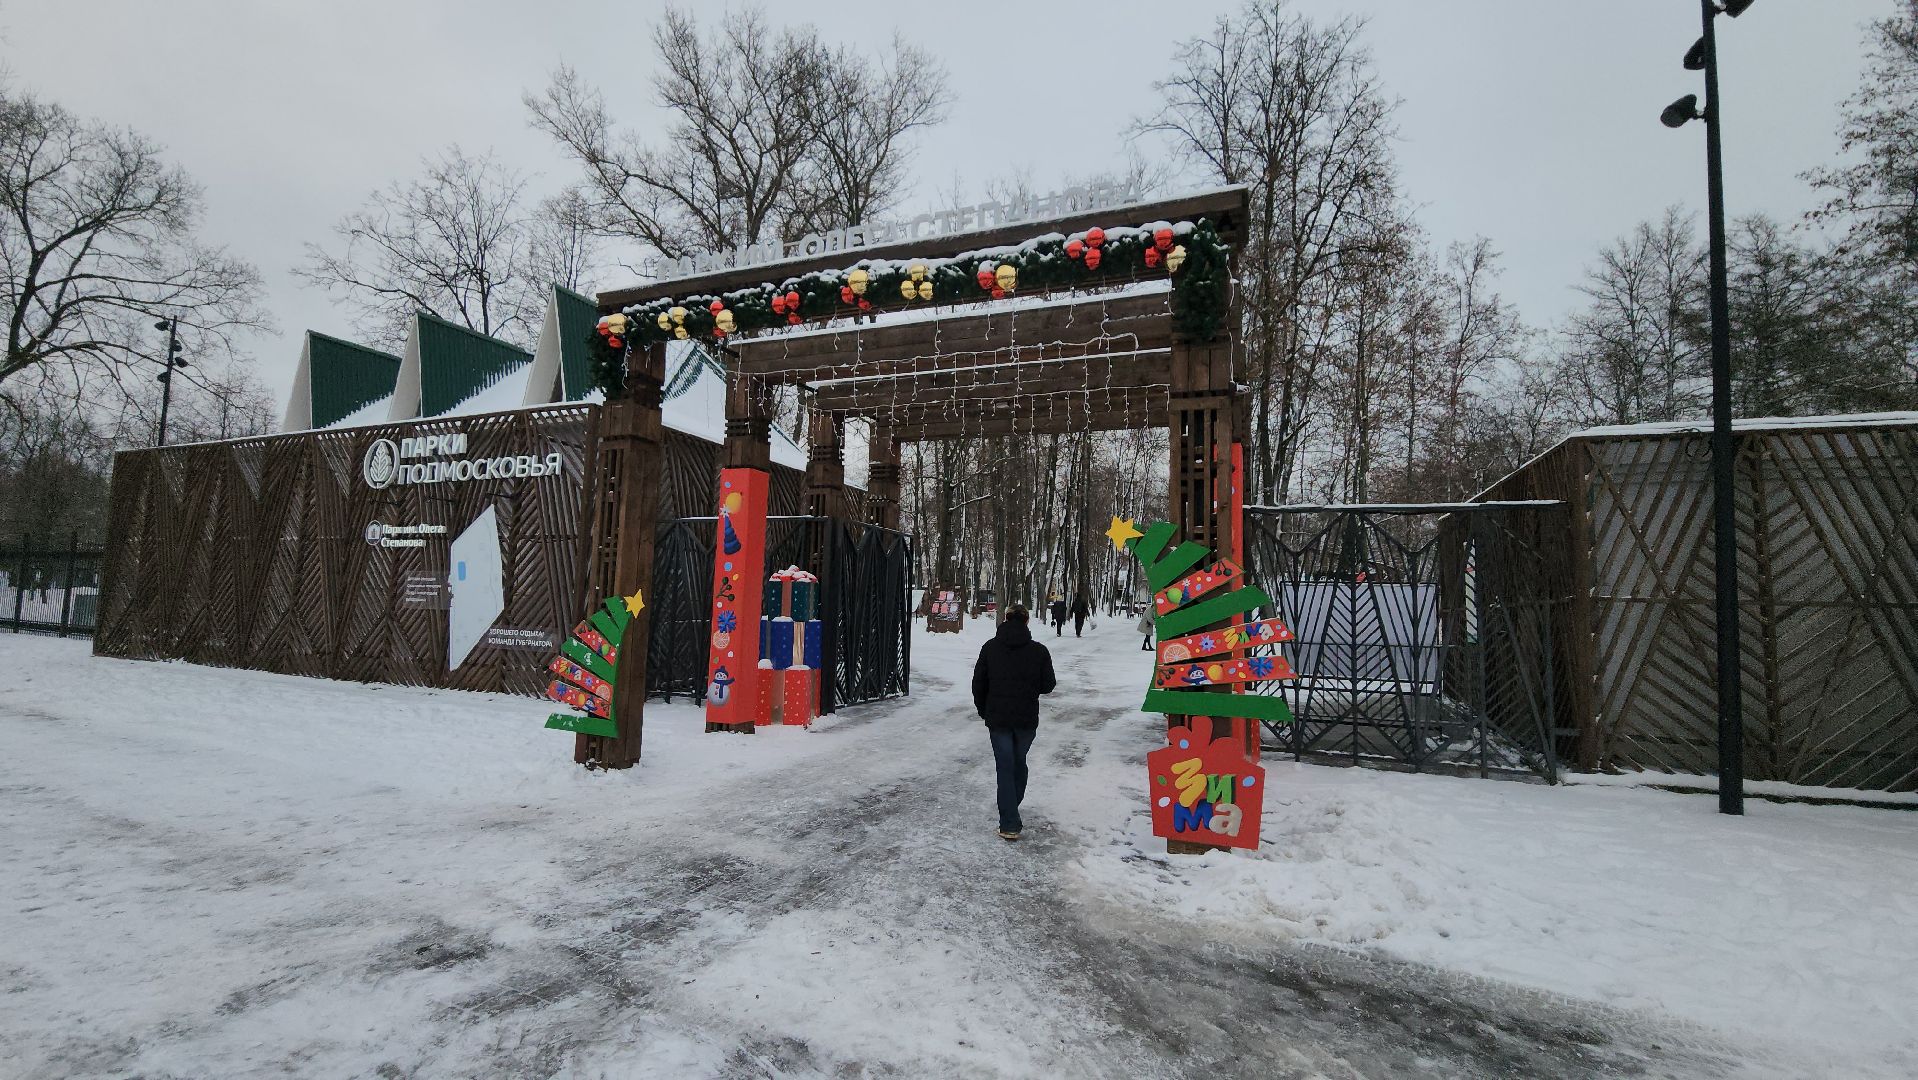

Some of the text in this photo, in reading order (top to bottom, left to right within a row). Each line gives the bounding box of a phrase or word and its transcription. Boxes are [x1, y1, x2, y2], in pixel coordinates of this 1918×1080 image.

[401, 433, 468, 458] ПАРКИ
[398, 453, 562, 485] ПОДМОСКОВЬЯ
[418, 524, 447, 534] Олега
[381, 537, 426, 547] Степанова
